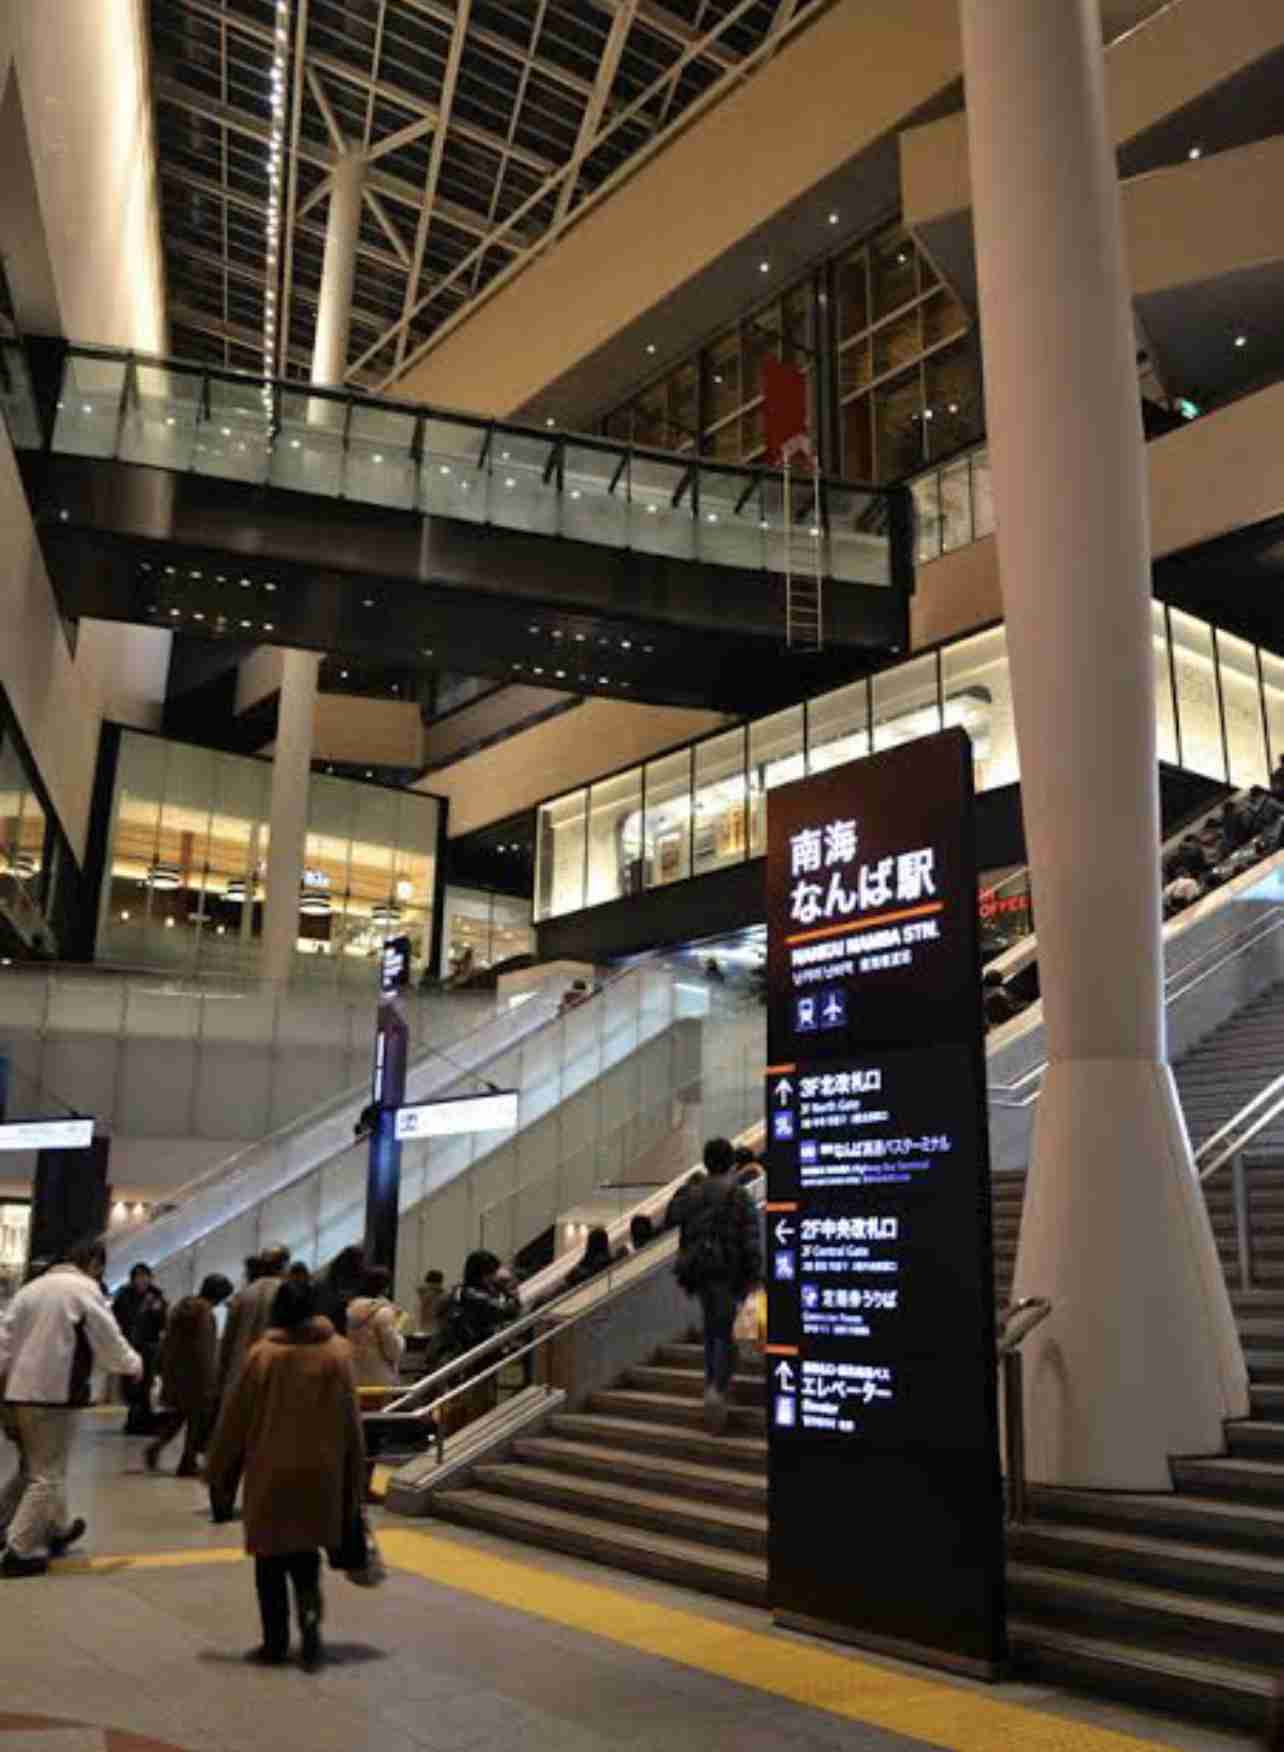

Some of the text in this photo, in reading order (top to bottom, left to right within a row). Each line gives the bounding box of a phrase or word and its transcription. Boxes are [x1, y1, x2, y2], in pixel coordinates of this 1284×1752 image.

[790, 820, 857, 876] 南海
[790, 848, 936, 923] なんば駅
[801, 1376, 893, 1404] エレベーター
